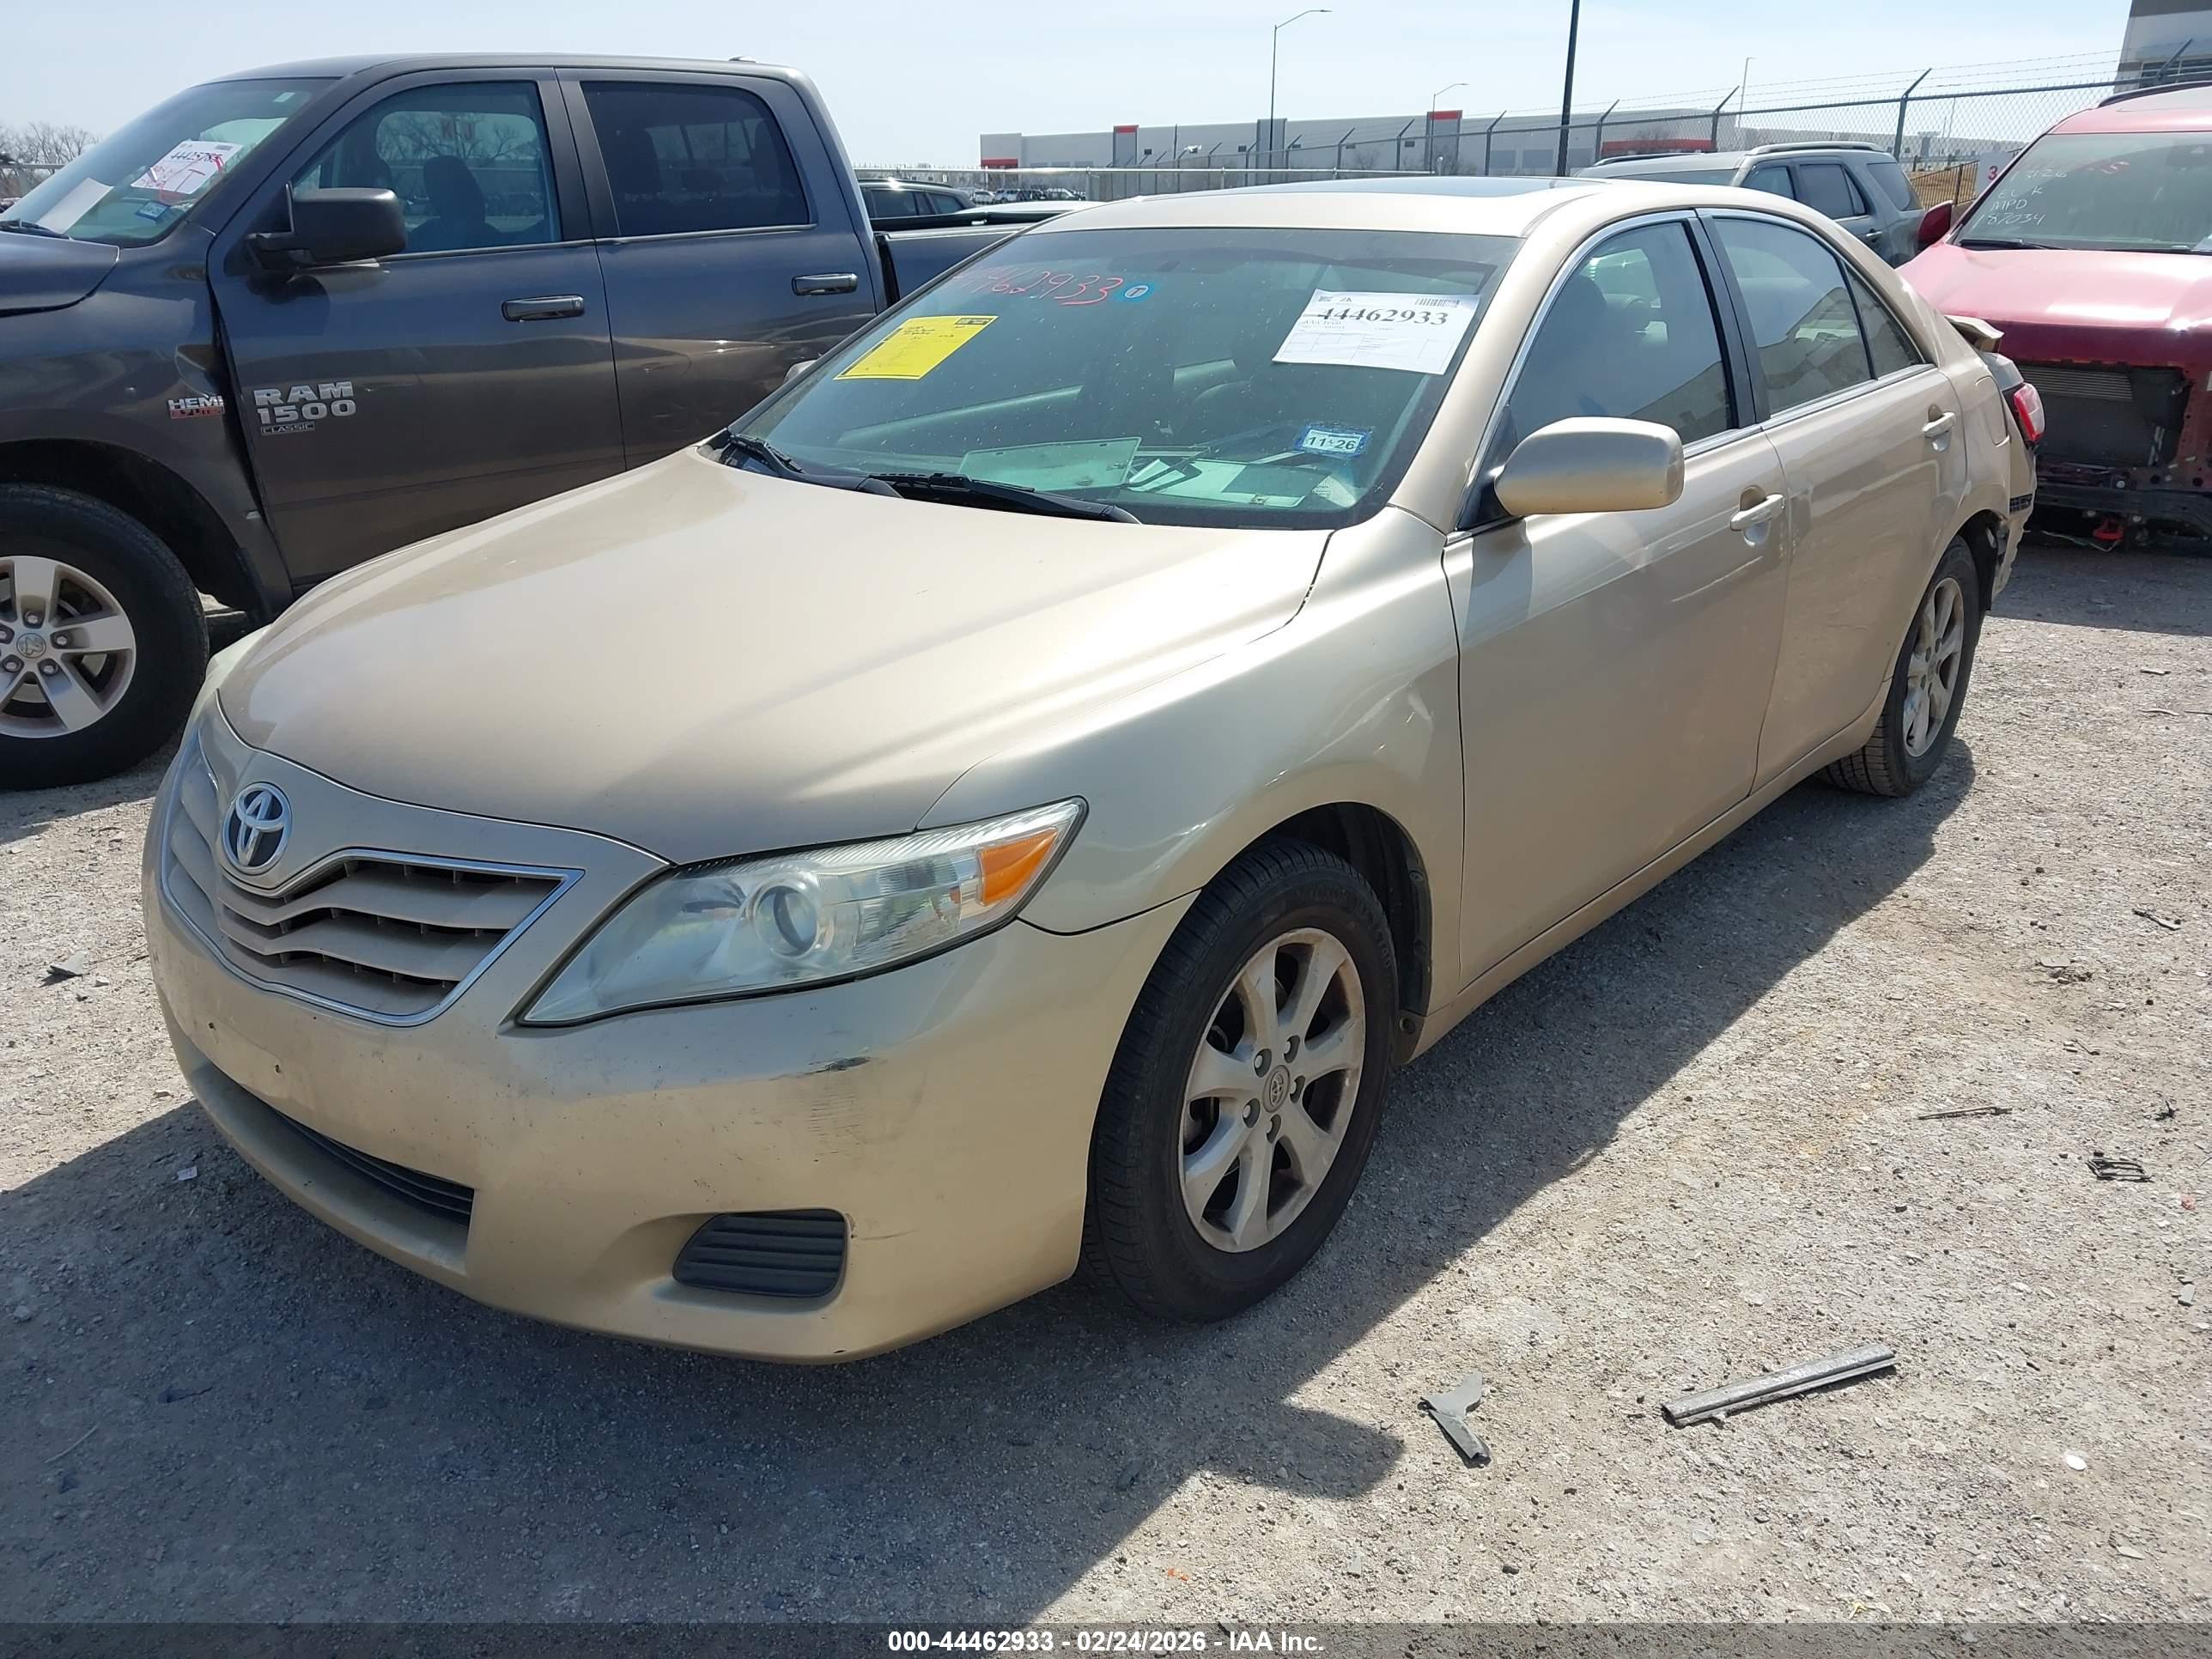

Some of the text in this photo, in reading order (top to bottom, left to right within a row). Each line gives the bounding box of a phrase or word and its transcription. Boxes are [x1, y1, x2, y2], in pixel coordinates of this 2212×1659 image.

[1988, 166, 1998, 180] 3
[1305, 307, 1449, 325] 44462933
[254, 381, 354, 405] RAM
[168, 395, 224, 410] HEMI
[257, 399, 356, 424] 1500
[263, 422, 314, 434] CLASSIC
[1334, 439, 1357, 450] 26
